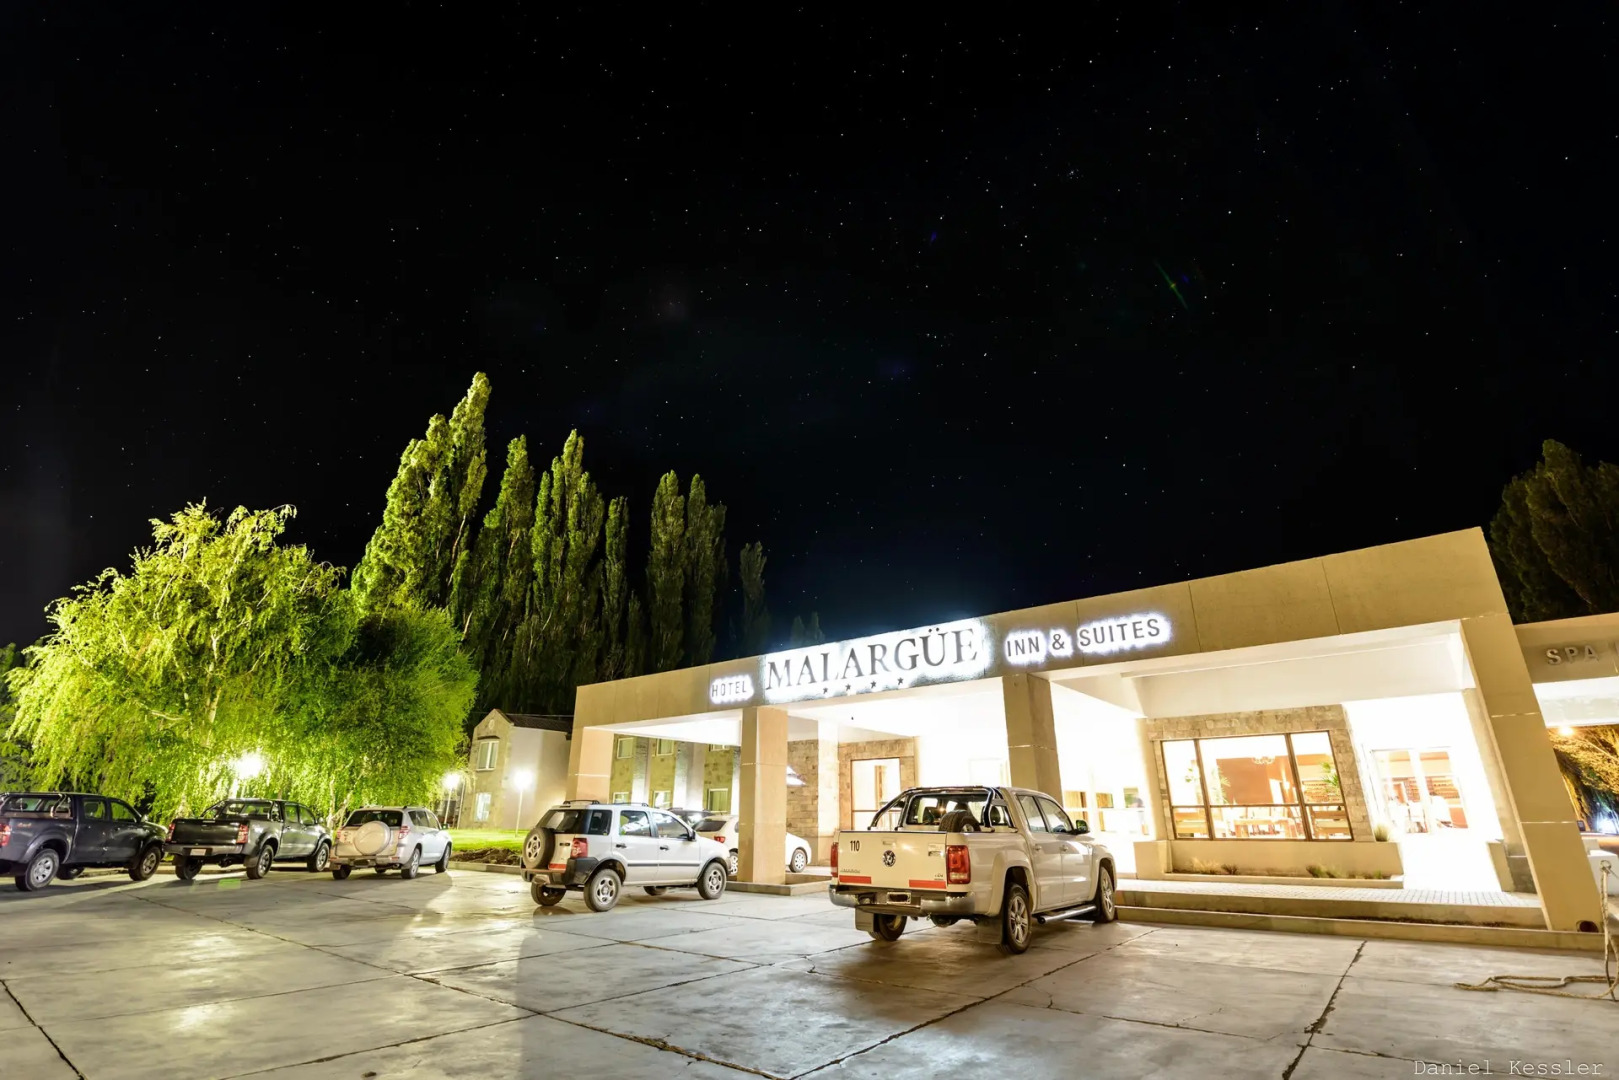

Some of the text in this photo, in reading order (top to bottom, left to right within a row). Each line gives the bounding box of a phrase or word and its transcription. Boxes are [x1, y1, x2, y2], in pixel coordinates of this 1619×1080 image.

[711, 618, 1161, 698] HOTEL MALARGÜE INN & SUITES
[1546, 645, 1599, 665] SPA
[850, 840, 860, 852] 110
